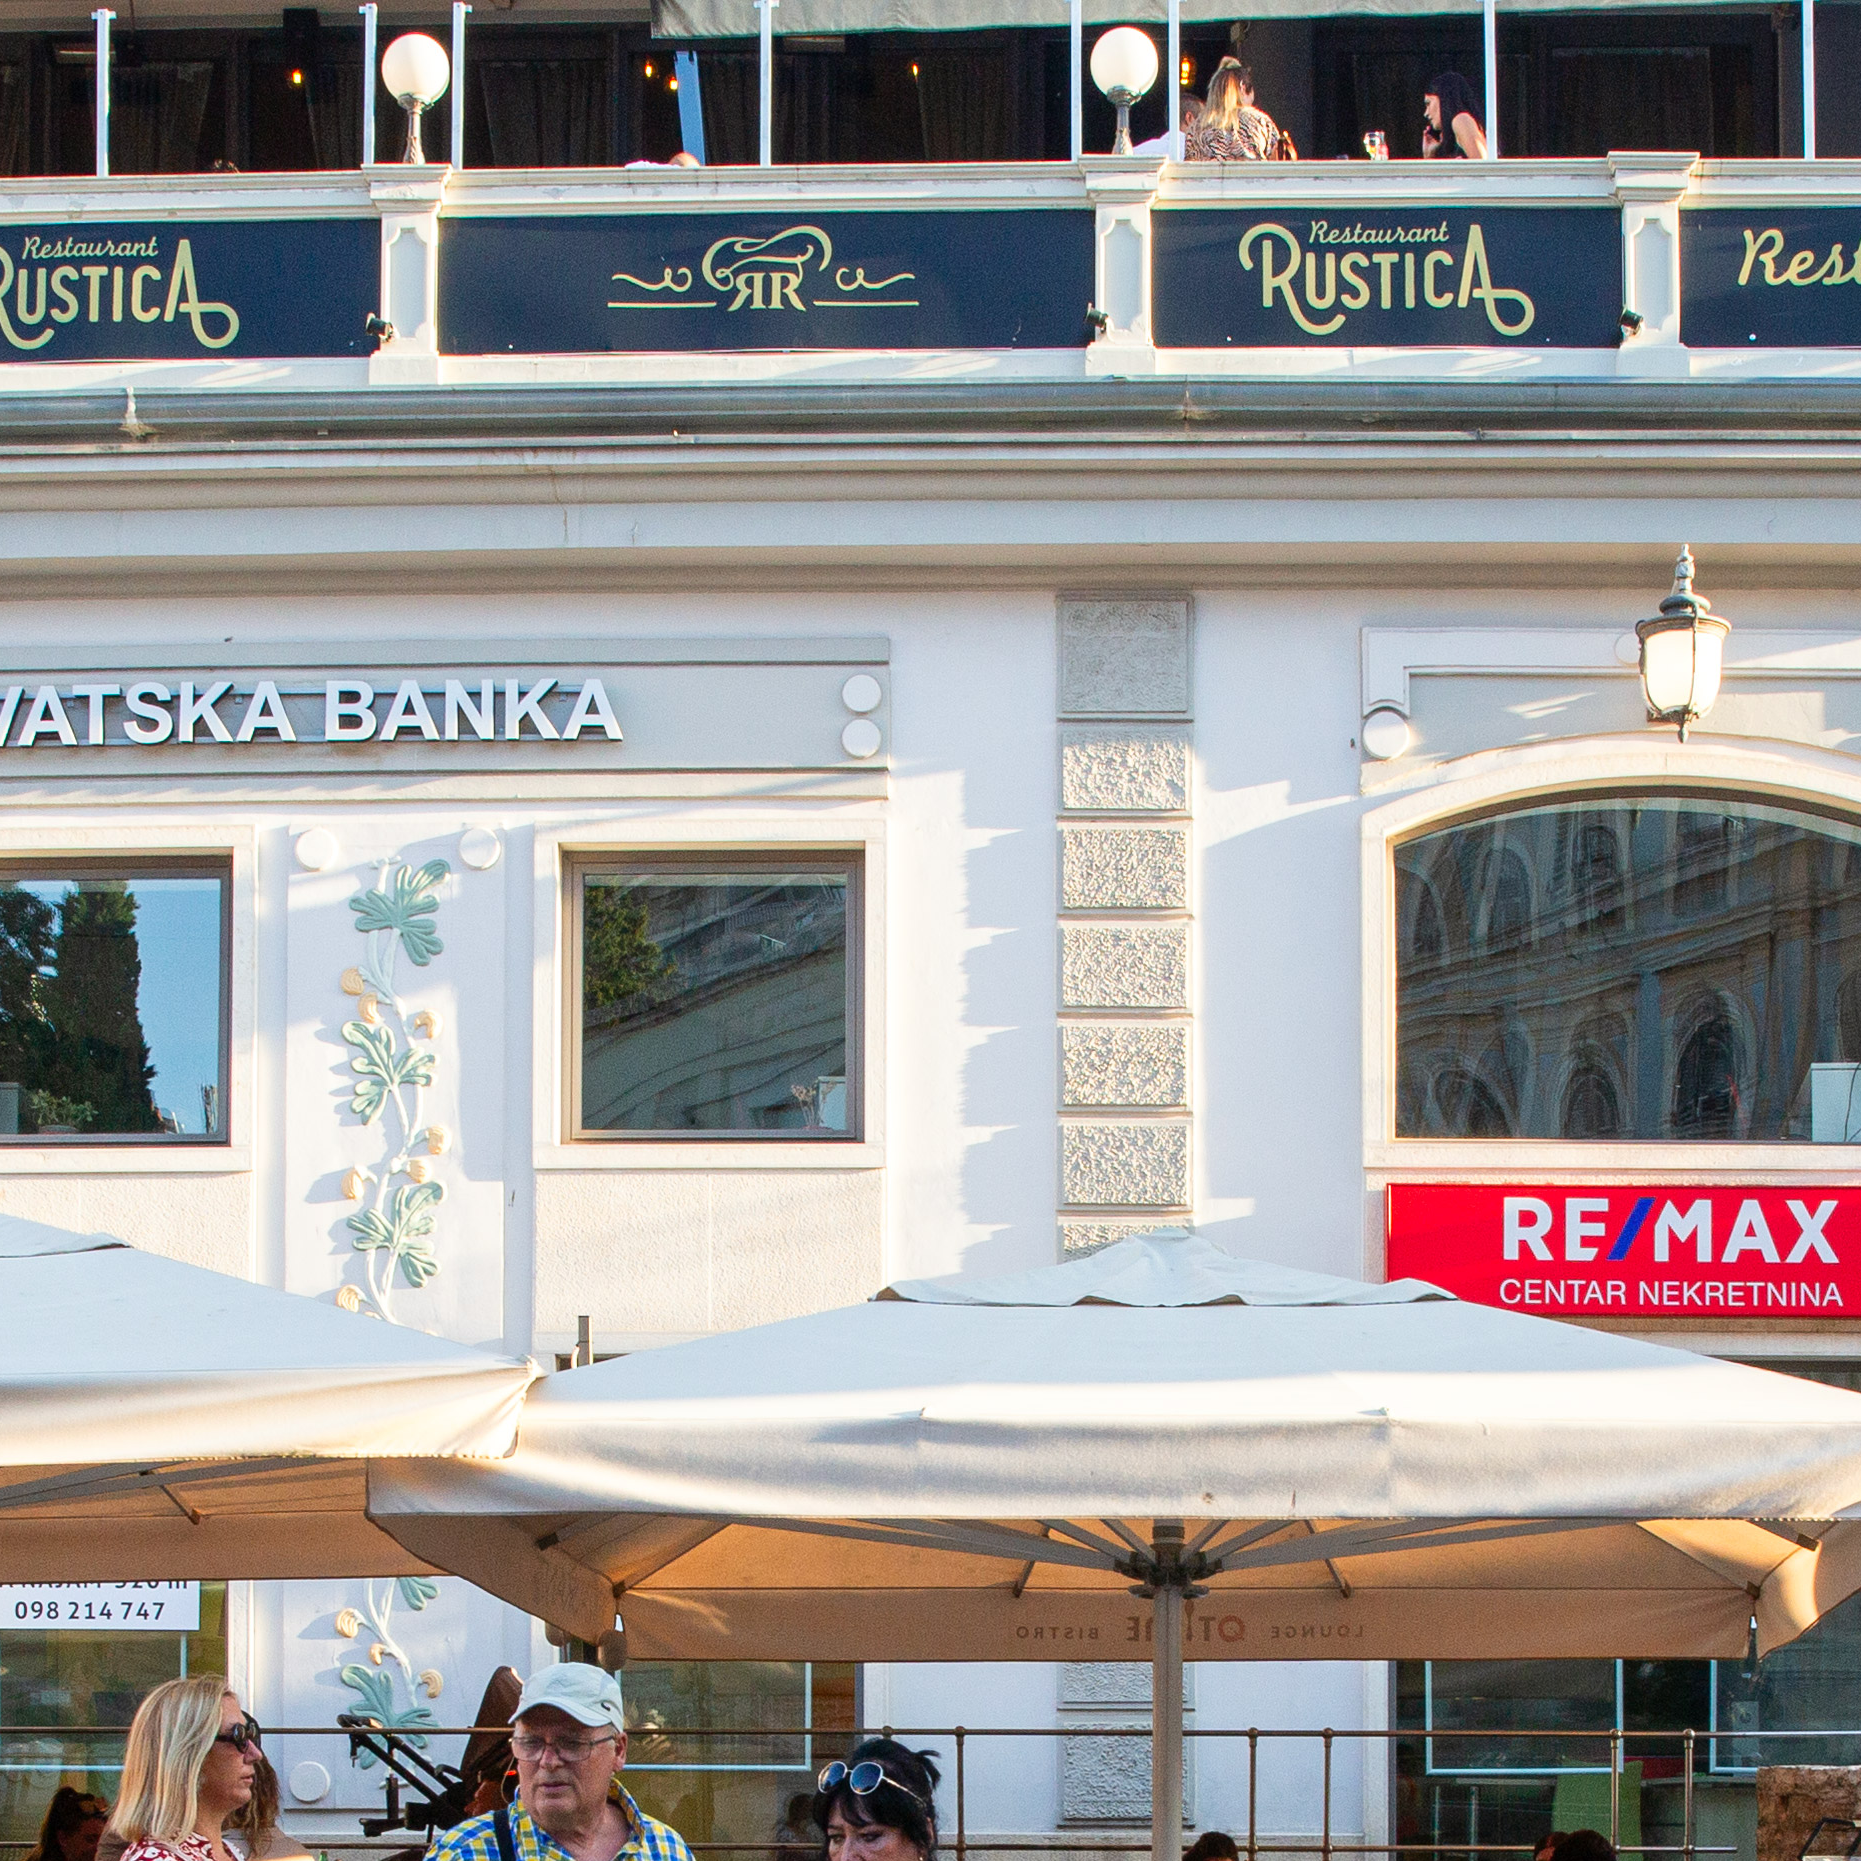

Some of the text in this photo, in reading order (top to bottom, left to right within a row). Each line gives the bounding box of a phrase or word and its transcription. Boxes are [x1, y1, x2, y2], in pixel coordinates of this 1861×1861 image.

[1309, 220, 1449, 244] Restaurant
[22, 236, 158, 260] Restaurant
[1239, 223, 1535, 337] RUSTICA
[324, 678, 624, 743] BANKA
[1502, 1196, 1841, 1264] RE/MAX
[1499, 1278, 1844, 1308] CENTAR NEKRETNINA
[14, 1601, 166, 1621] 098 214 747
